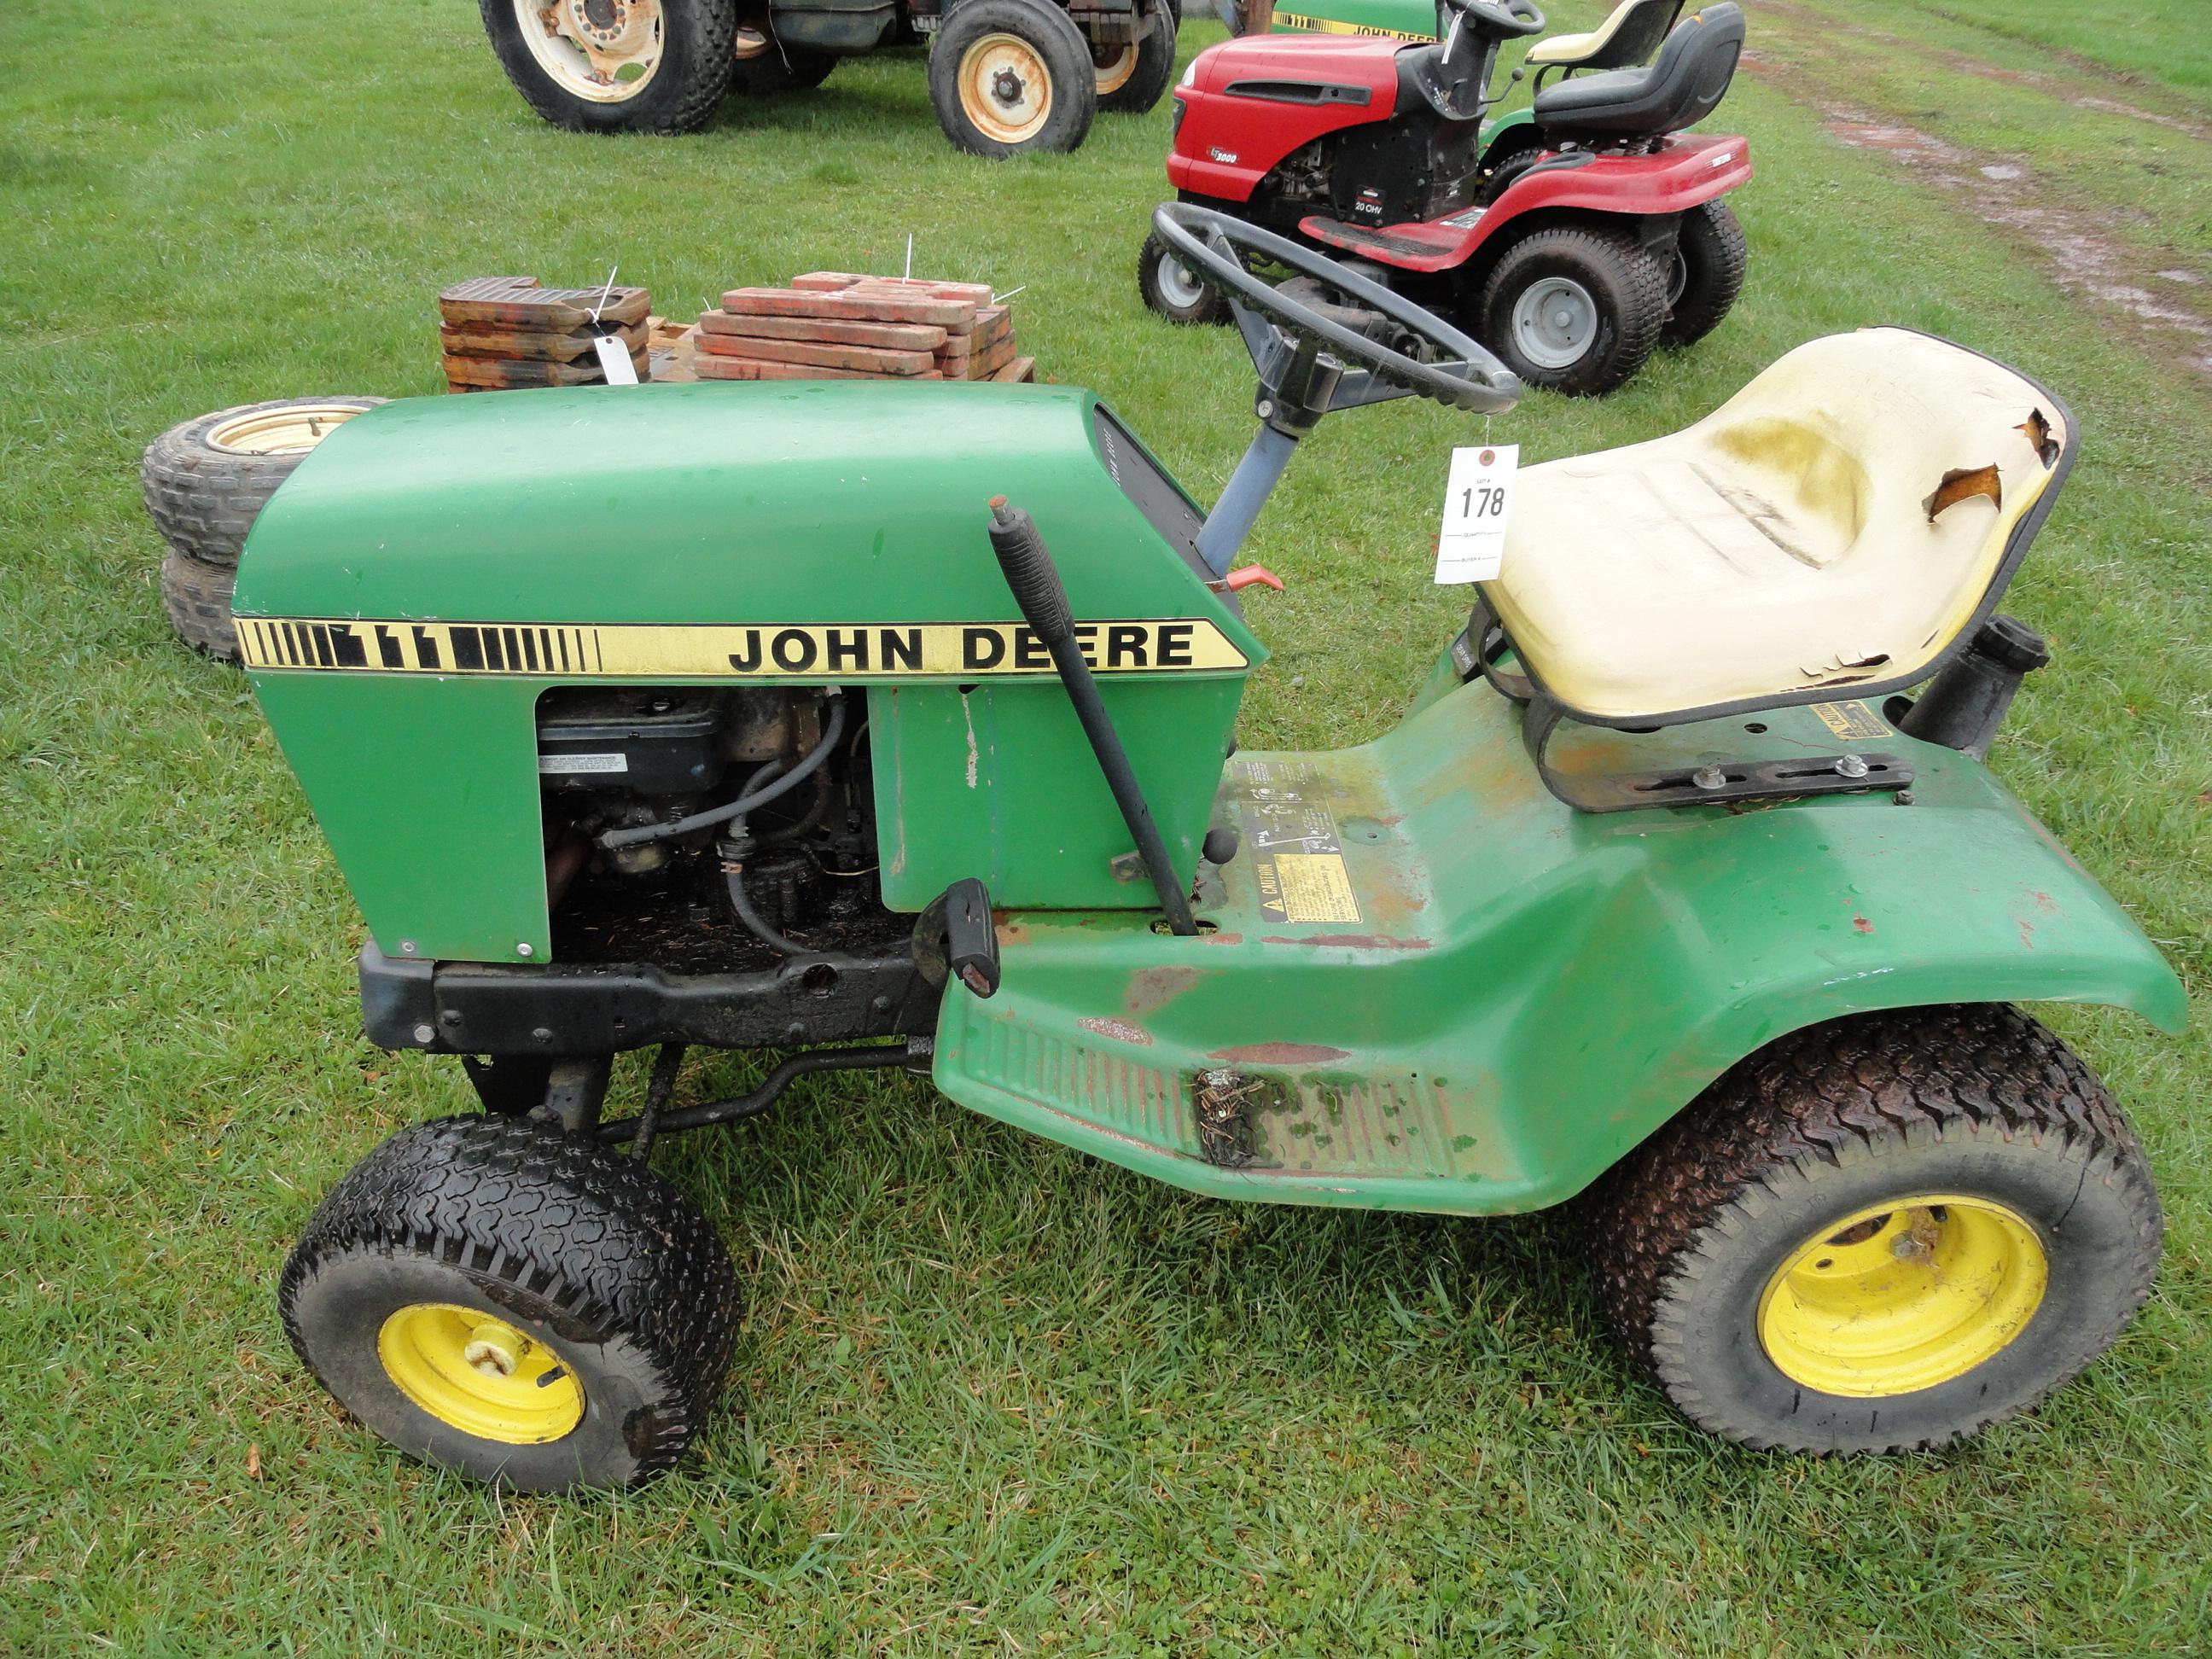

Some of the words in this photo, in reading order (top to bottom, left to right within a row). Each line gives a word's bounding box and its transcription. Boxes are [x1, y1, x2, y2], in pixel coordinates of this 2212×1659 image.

[1354, 201, 1365, 212] 20
[1463, 487, 1505, 517] 178
[348, 624, 452, 671] 111
[729, 628, 924, 672] JOHN
[1257, 864, 1278, 894] CAUTION
